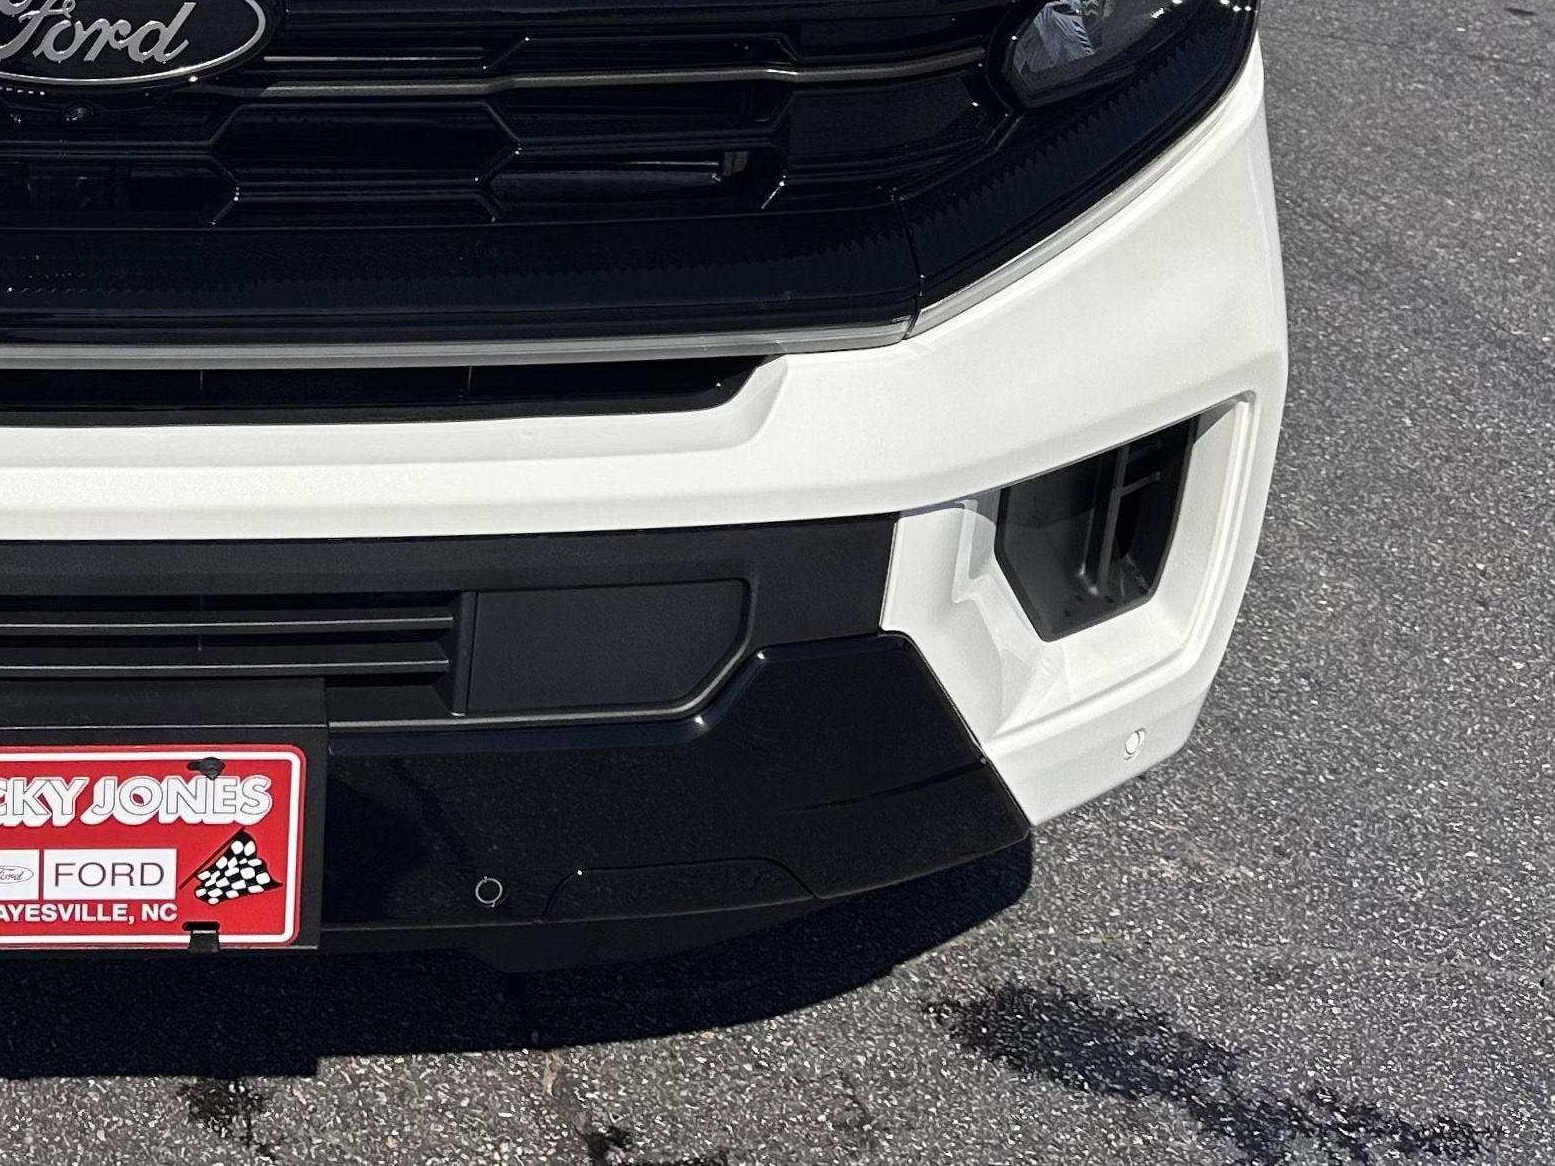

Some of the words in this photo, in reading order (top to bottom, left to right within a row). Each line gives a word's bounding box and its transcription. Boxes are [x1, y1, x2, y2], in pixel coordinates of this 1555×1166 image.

[78, 775, 273, 827] JONES
[54, 861, 165, 887] FORD
[141, 902, 178, 923] NC
